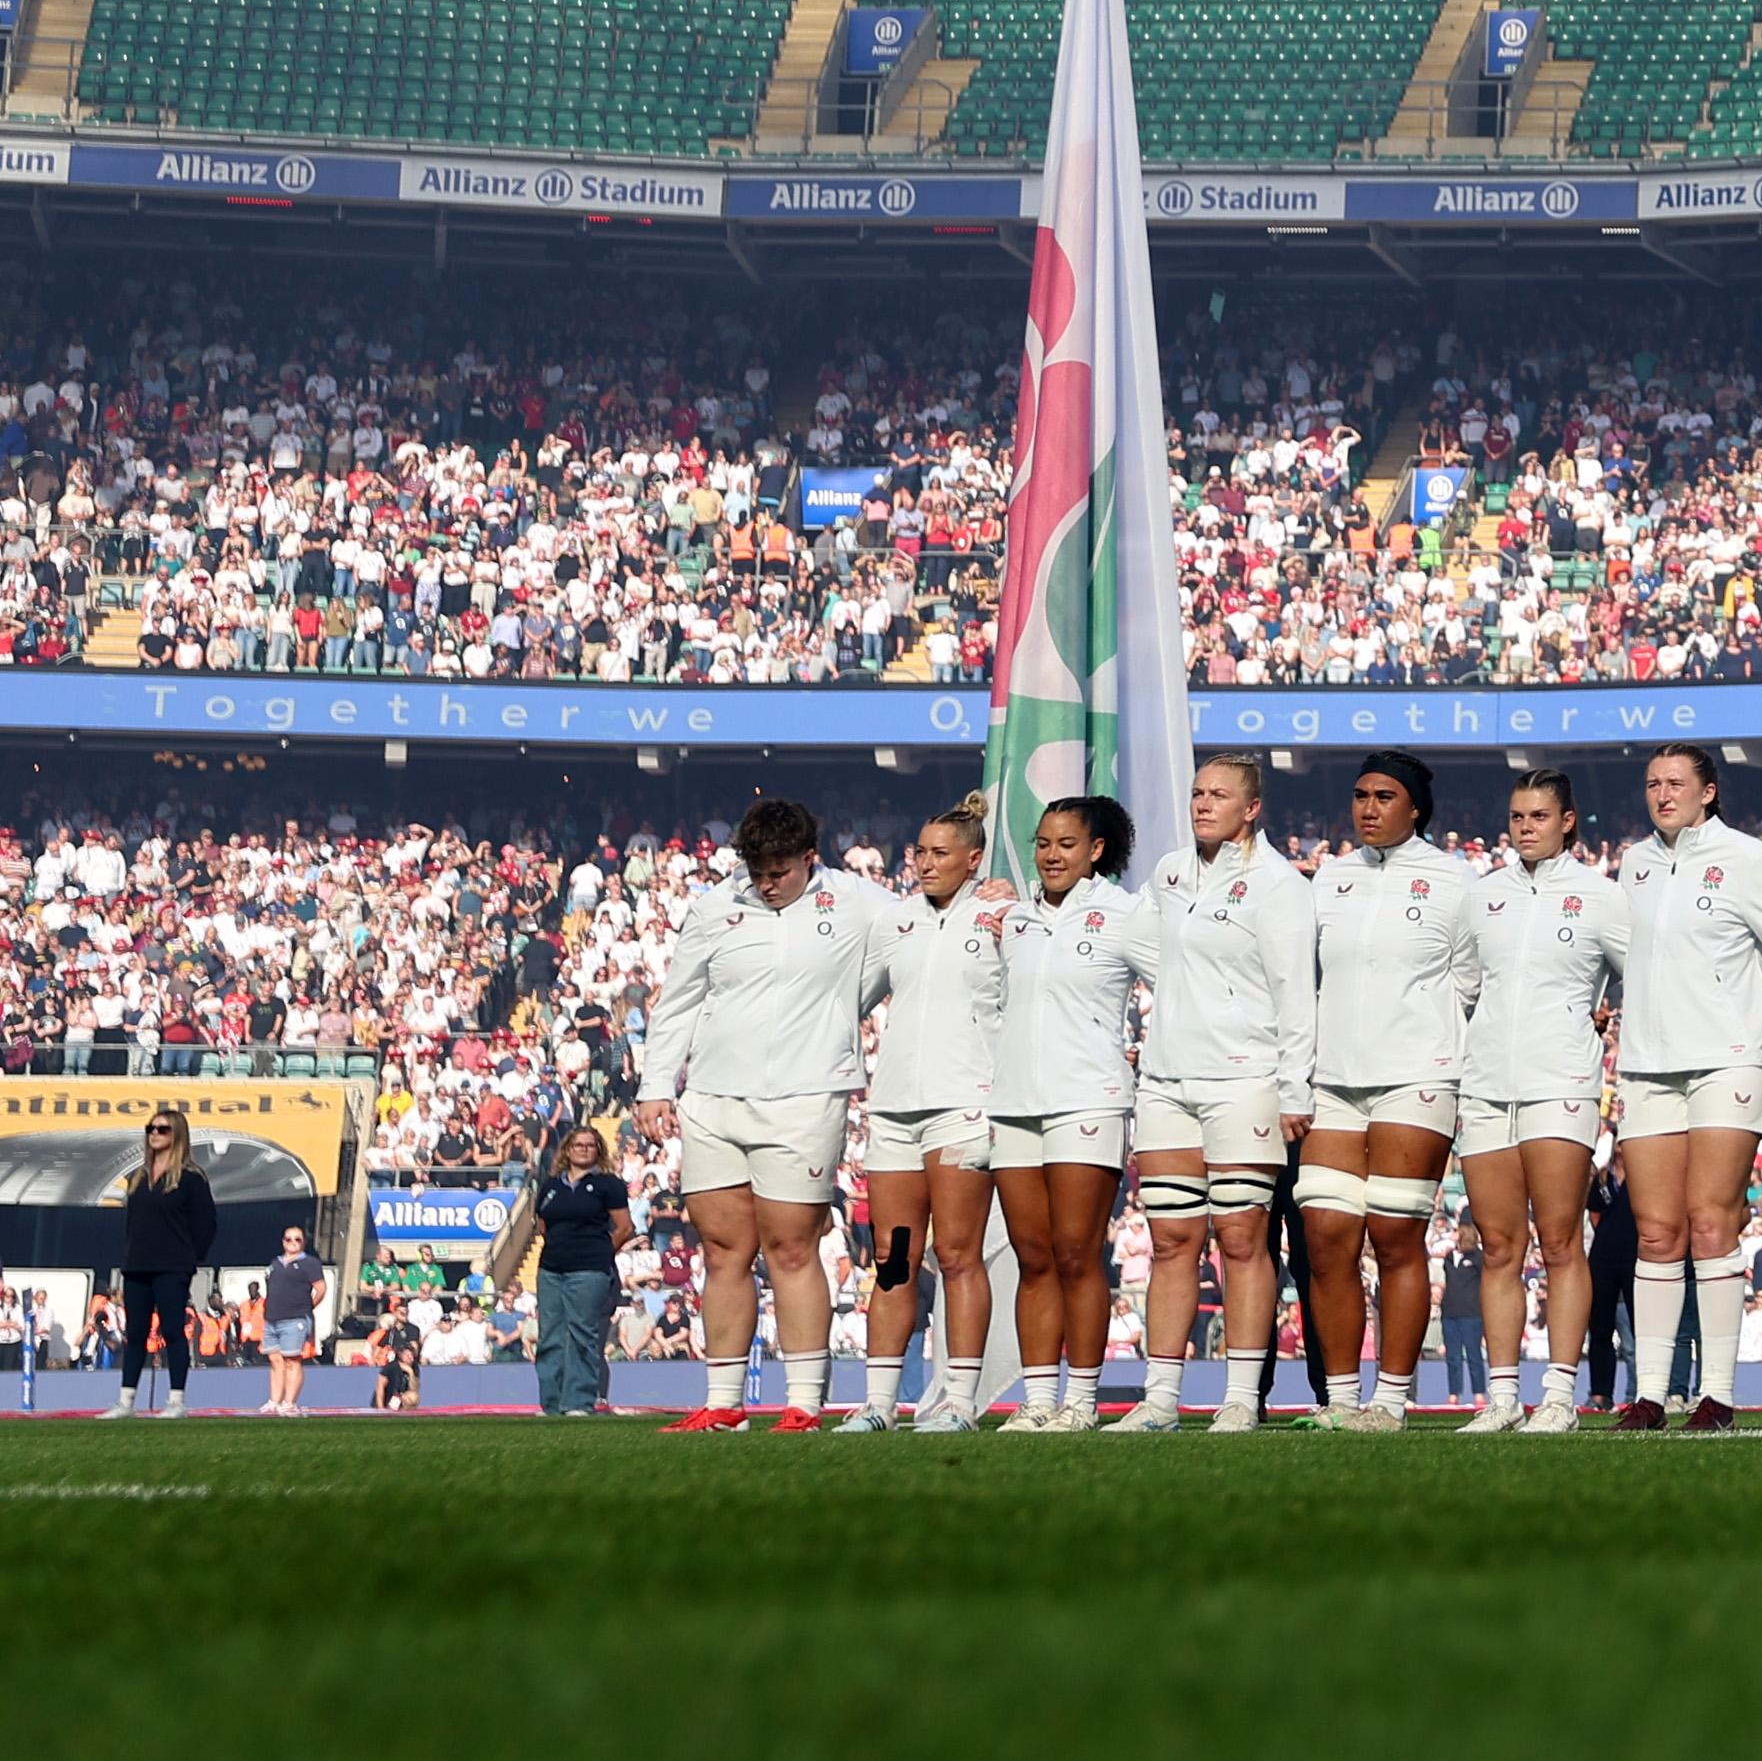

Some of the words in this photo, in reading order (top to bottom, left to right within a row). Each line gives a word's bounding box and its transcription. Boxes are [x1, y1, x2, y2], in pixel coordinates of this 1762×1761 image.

[156, 152, 267, 185] Allianz
[420, 167, 526, 198] Allianz
[580, 173, 704, 206] Stadium
[770, 182, 871, 212] Allianz
[1200, 184, 1318, 212] Stadium
[1433, 185, 1535, 213] Allianz
[1655, 179, 1746, 208] Allianz
[807, 489, 862, 506] Allianz
[145, 684, 580, 731] Together
[627, 707, 714, 733] we
[1189, 700, 1578, 744] Together
[1619, 704, 1697, 730] we
[374, 1202, 471, 1228] Allianz
